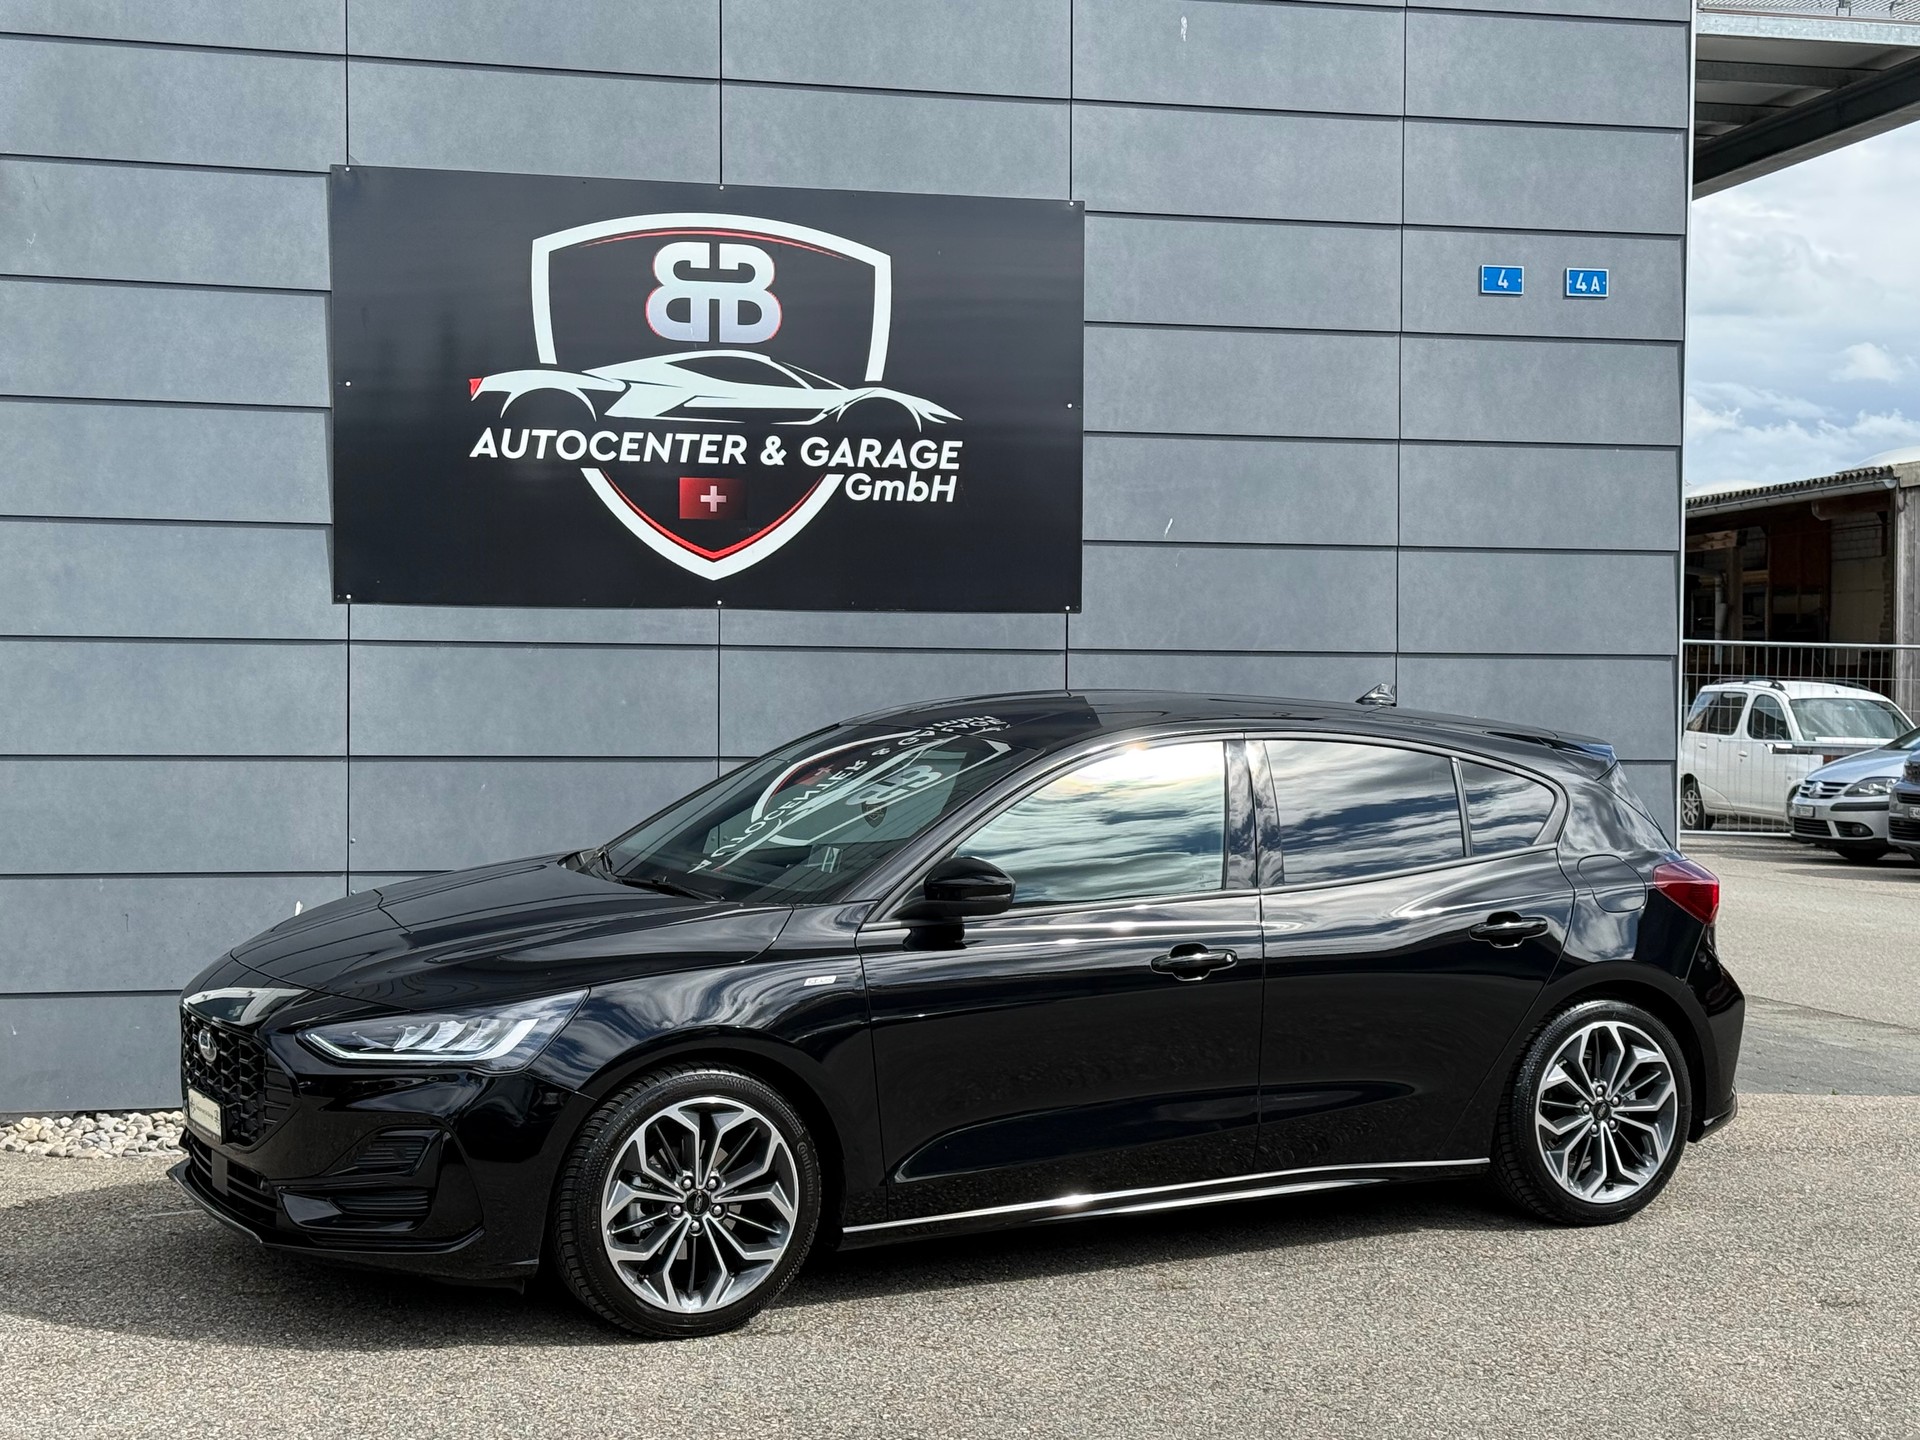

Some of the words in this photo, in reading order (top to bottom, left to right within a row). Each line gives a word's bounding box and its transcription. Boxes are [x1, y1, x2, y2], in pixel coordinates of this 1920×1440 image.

[1497, 269, 1509, 289] 4
[1575, 272, 1601, 292] 4A
[469, 427, 748, 465] AUTOCENTER
[760, 435, 787, 466] &
[800, 436, 963, 470] GARAGE
[845, 471, 957, 503] GmbH
